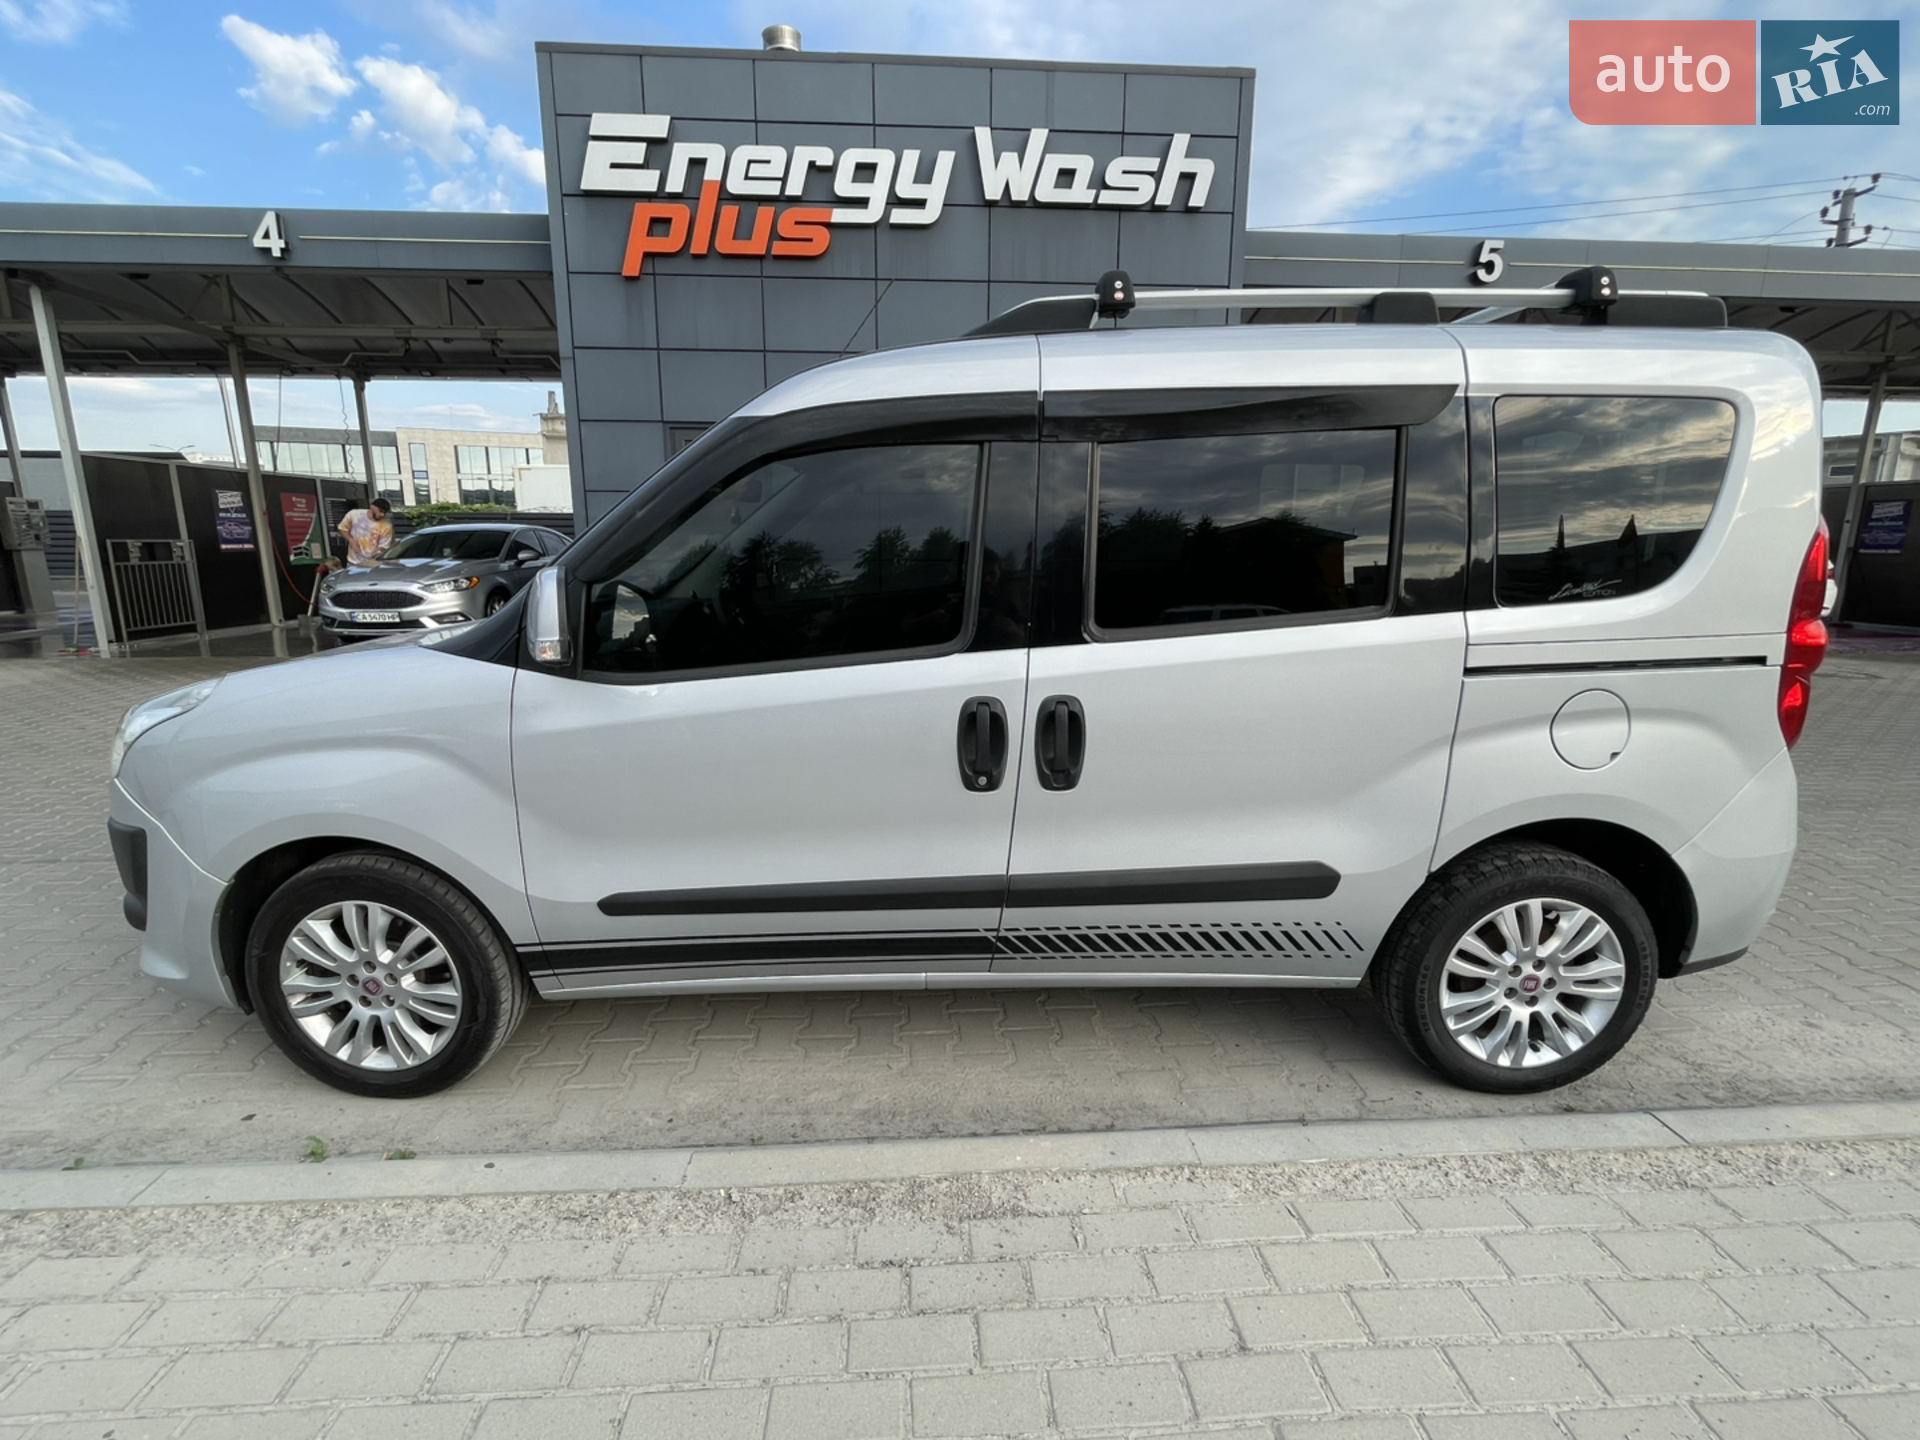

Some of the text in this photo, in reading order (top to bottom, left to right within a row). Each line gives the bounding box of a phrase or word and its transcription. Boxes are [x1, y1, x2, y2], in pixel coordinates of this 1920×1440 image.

[580, 112, 1215, 226] Energy Wash
[252, 210, 286, 258] 4
[621, 179, 834, 278] plus
[1476, 239, 1505, 283] 5
